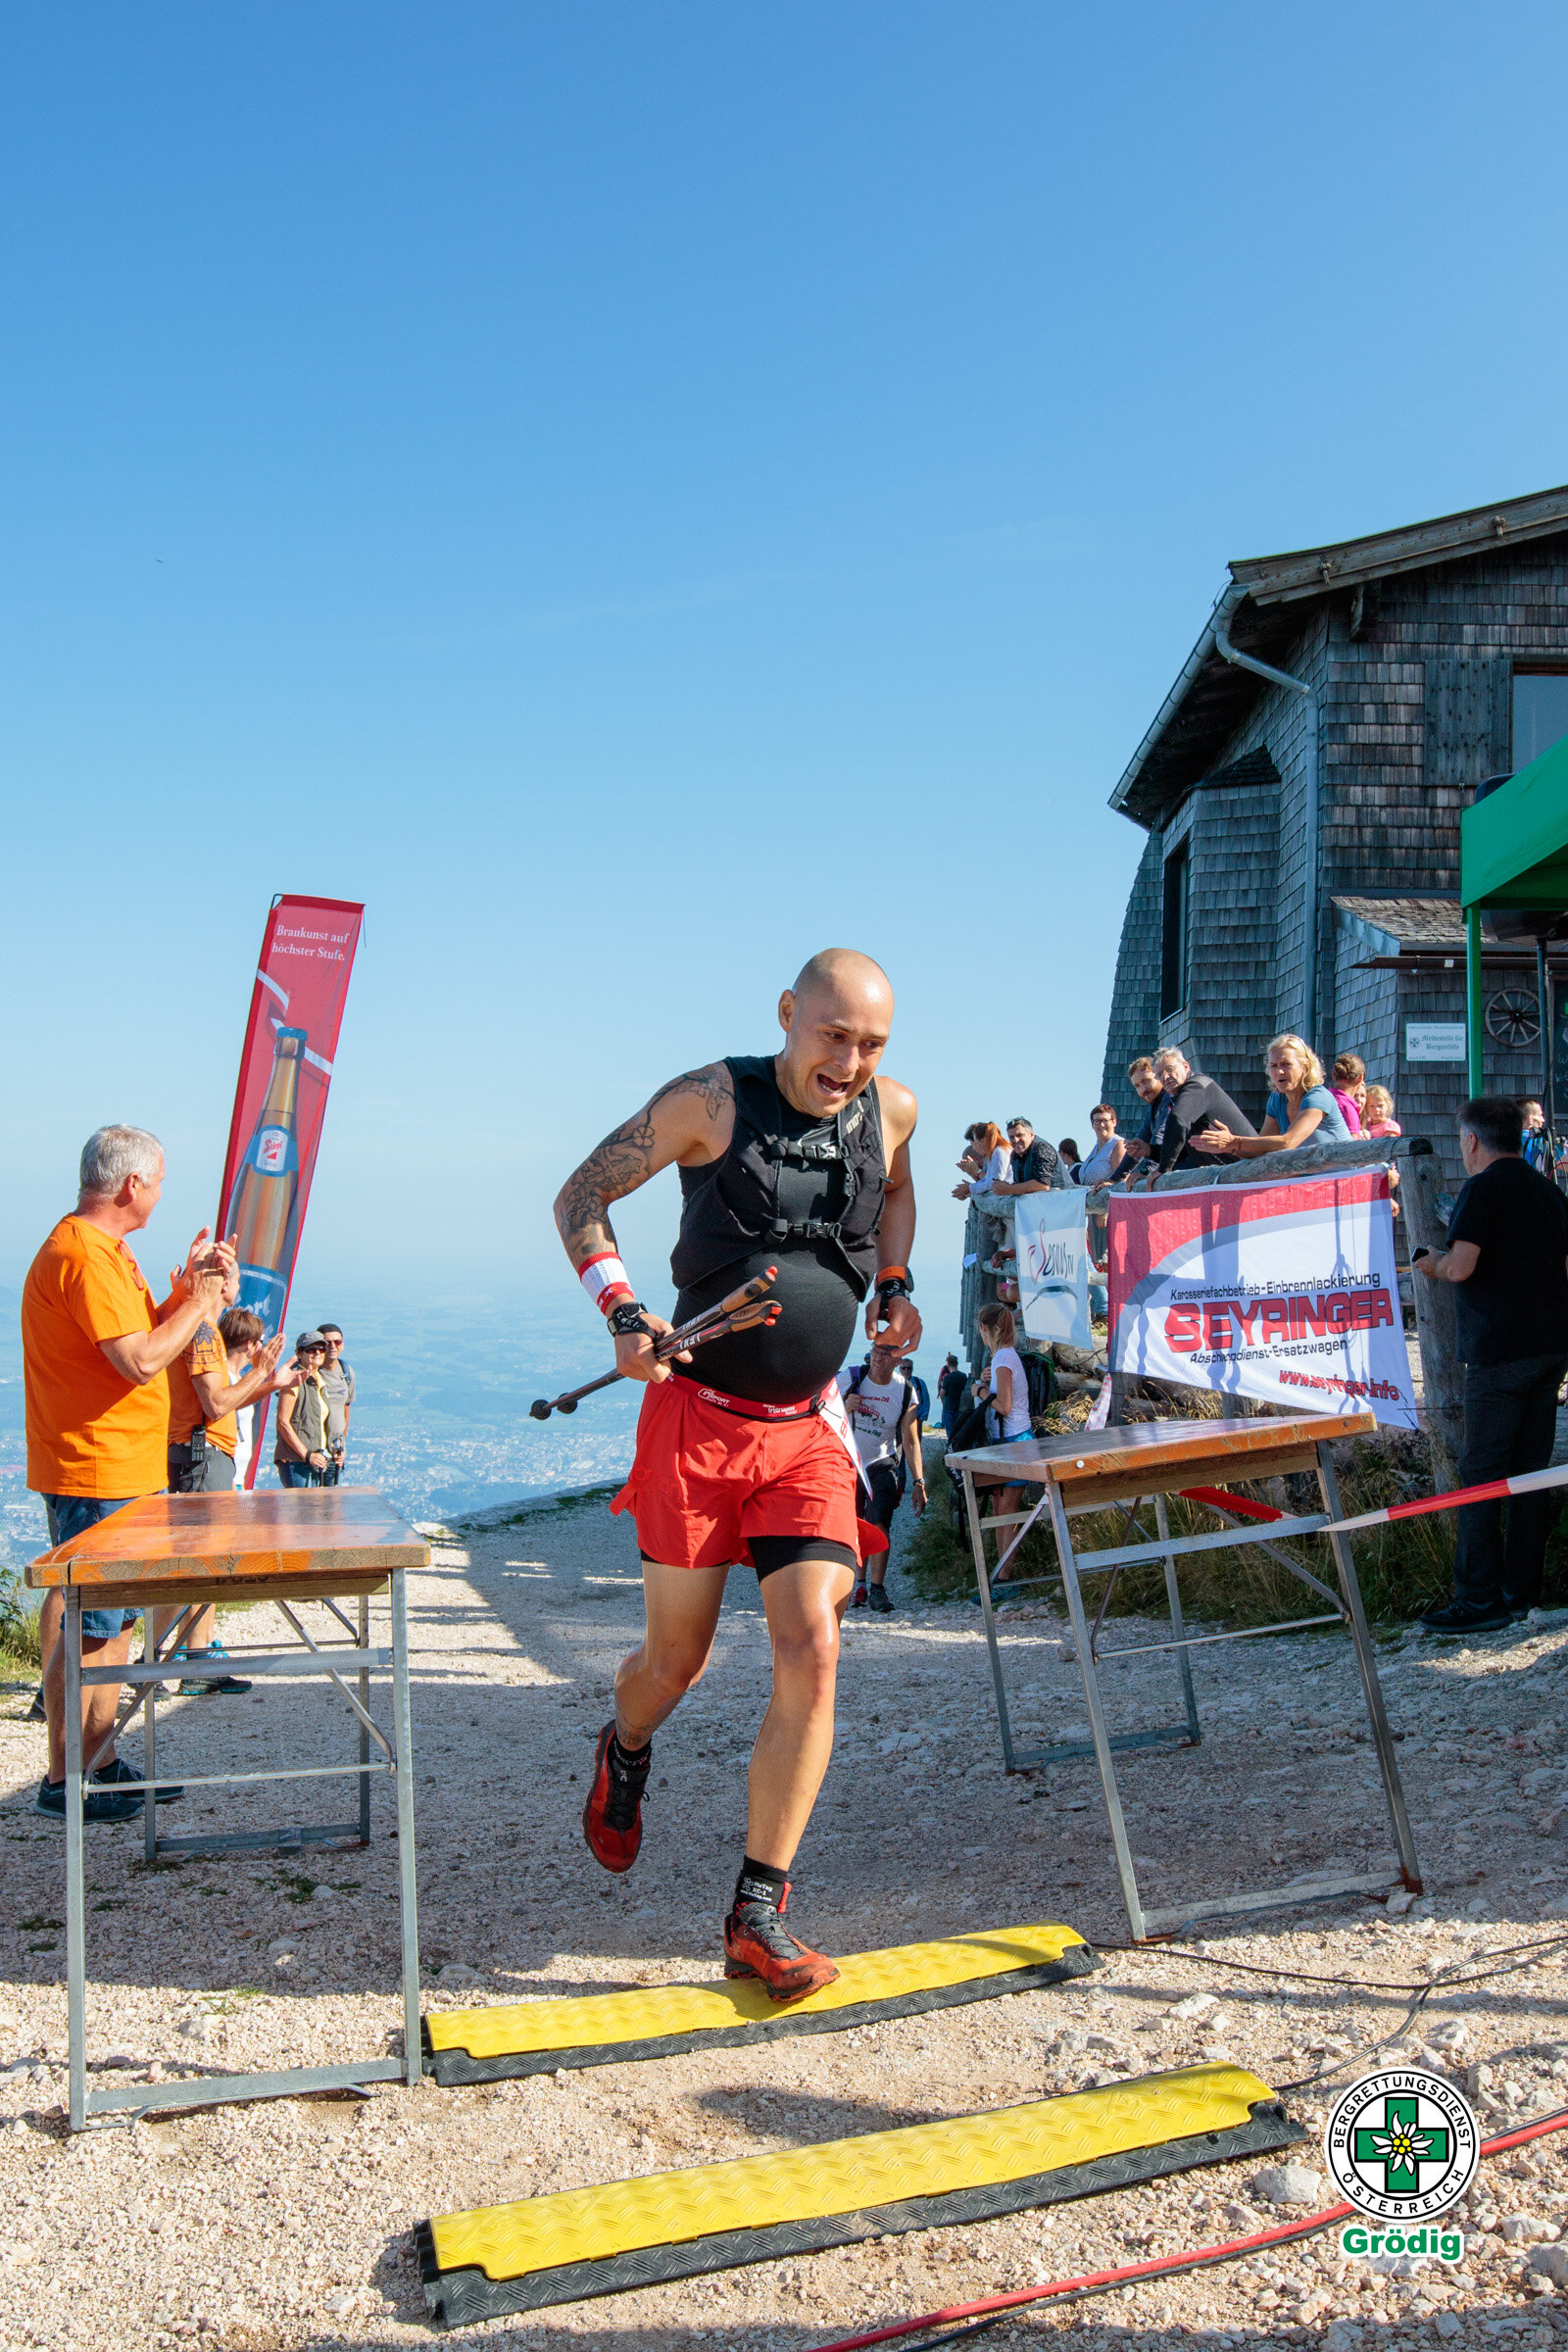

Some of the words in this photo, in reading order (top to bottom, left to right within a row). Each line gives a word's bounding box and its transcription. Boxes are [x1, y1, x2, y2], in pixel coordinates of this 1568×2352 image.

[275, 924, 328, 942] Braukunst
[330, 932, 351, 944] auf
[270, 942, 316, 957] höchster
[317, 947, 346, 961] Stufe.
[1164, 1288, 1395, 1353] SEYRINGER
[1279, 1369, 1400, 1402] www.seyringer.info
